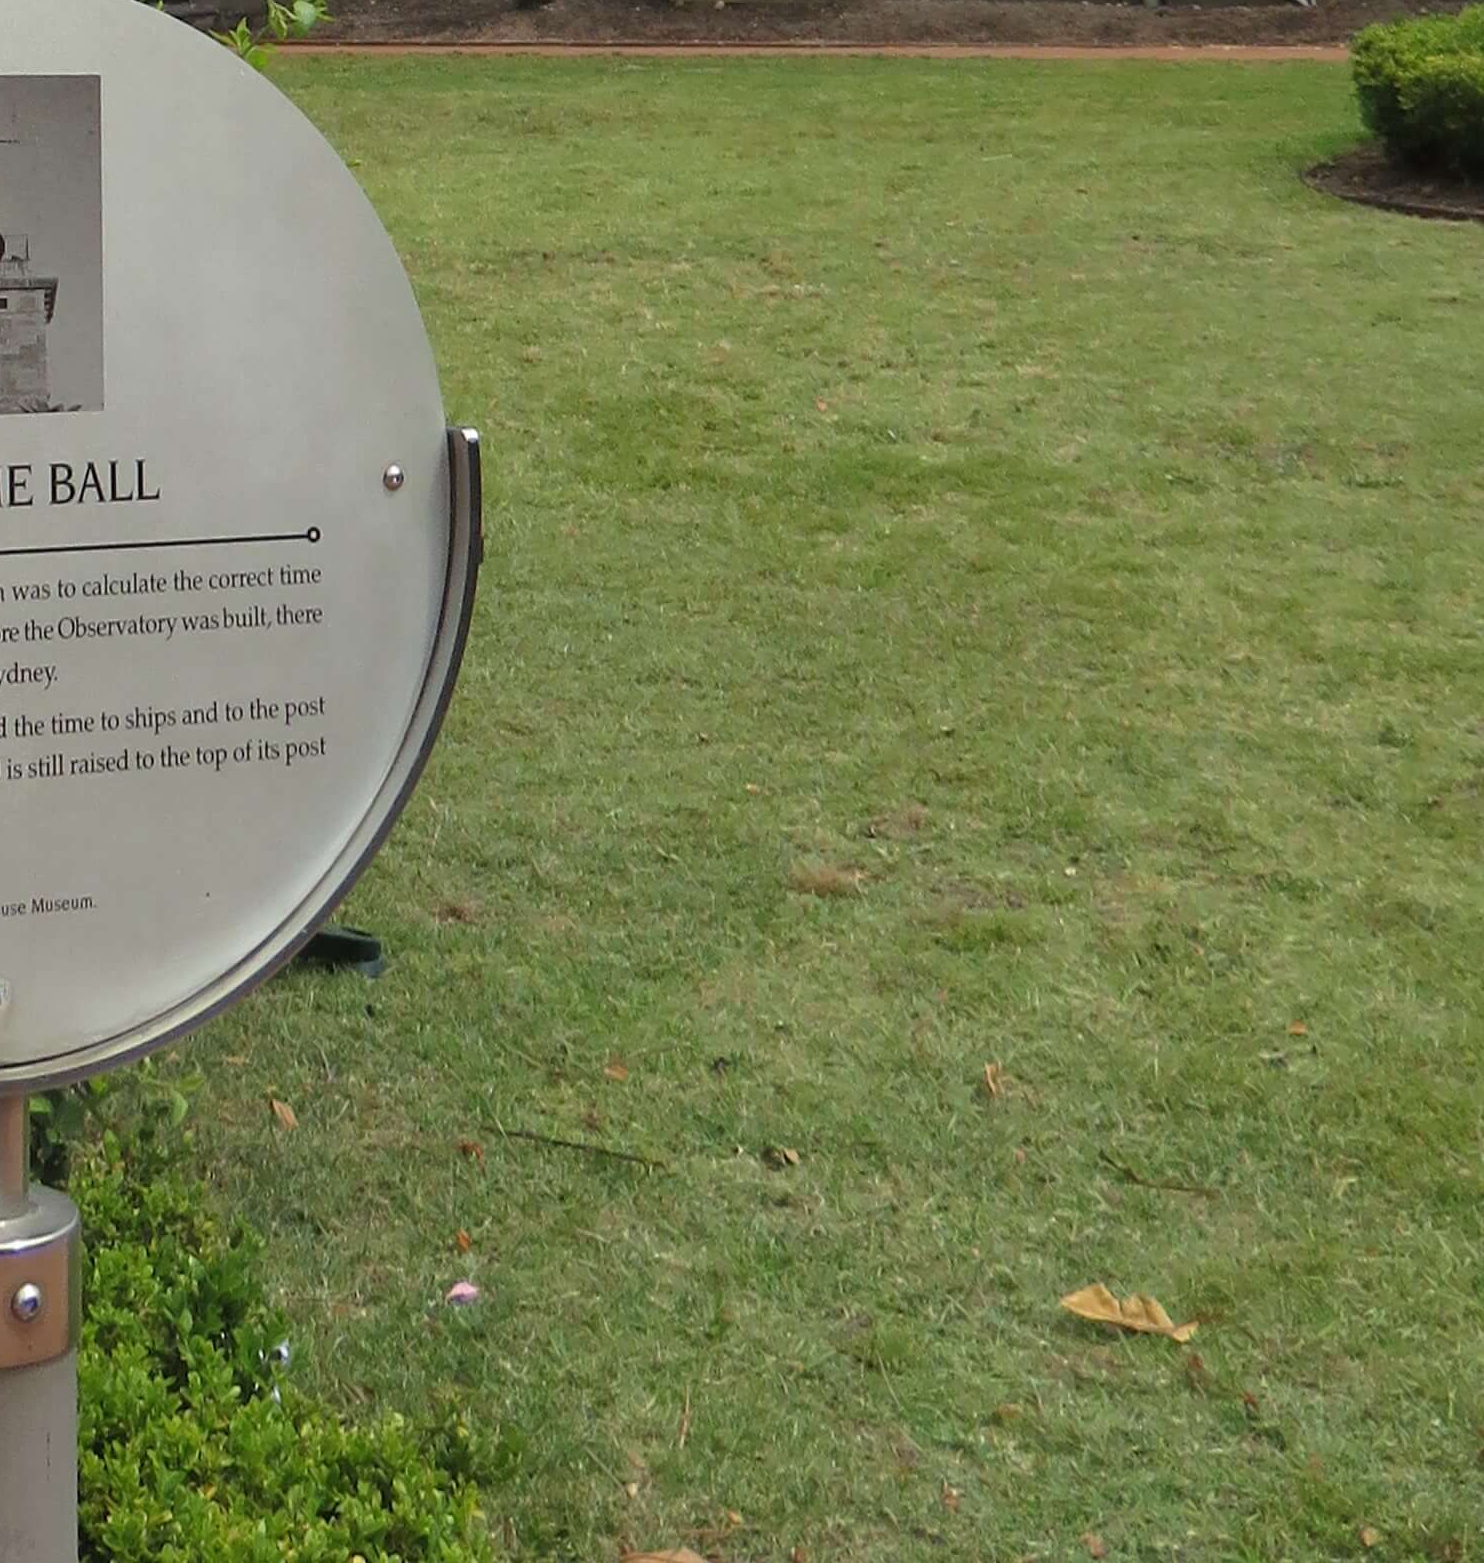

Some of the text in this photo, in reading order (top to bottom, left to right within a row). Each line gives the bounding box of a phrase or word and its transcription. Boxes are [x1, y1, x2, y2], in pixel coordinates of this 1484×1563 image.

[49, 459, 160, 506] BALL
[11, 584, 51, 601] was
[57, 579, 76, 599] to
[82, 572, 167, 597] calculate
[173, 569, 203, 592] the
[208, 567, 274, 590] correct
[280, 564, 321, 586] time
[24, 619, 54, 642] the
[57, 614, 178, 640] Observatory
[181, 614, 220, 631] was
[222, 605, 272, 629] built,
[276, 603, 323, 625] there
[14, 714, 45, 738] the
[51, 712, 95, 735] time
[101, 712, 120, 731] to
[125, 706, 177, 736] ships
[182, 701, 218, 725] and
[225, 703, 244, 722] to
[250, 698, 279, 721] the
[284, 696, 325, 726] post
[7, 758, 23, 780] is
[28, 753, 64, 779] still
[70, 748, 129, 775] raised
[135, 750, 155, 770] to
[160, 745, 190, 768] the
[196, 747, 227, 772] top
[233, 739, 253, 763] of
[258, 739, 280, 761] its
[285, 737, 326, 766] post
[31, 897, 96, 914] Museum.
